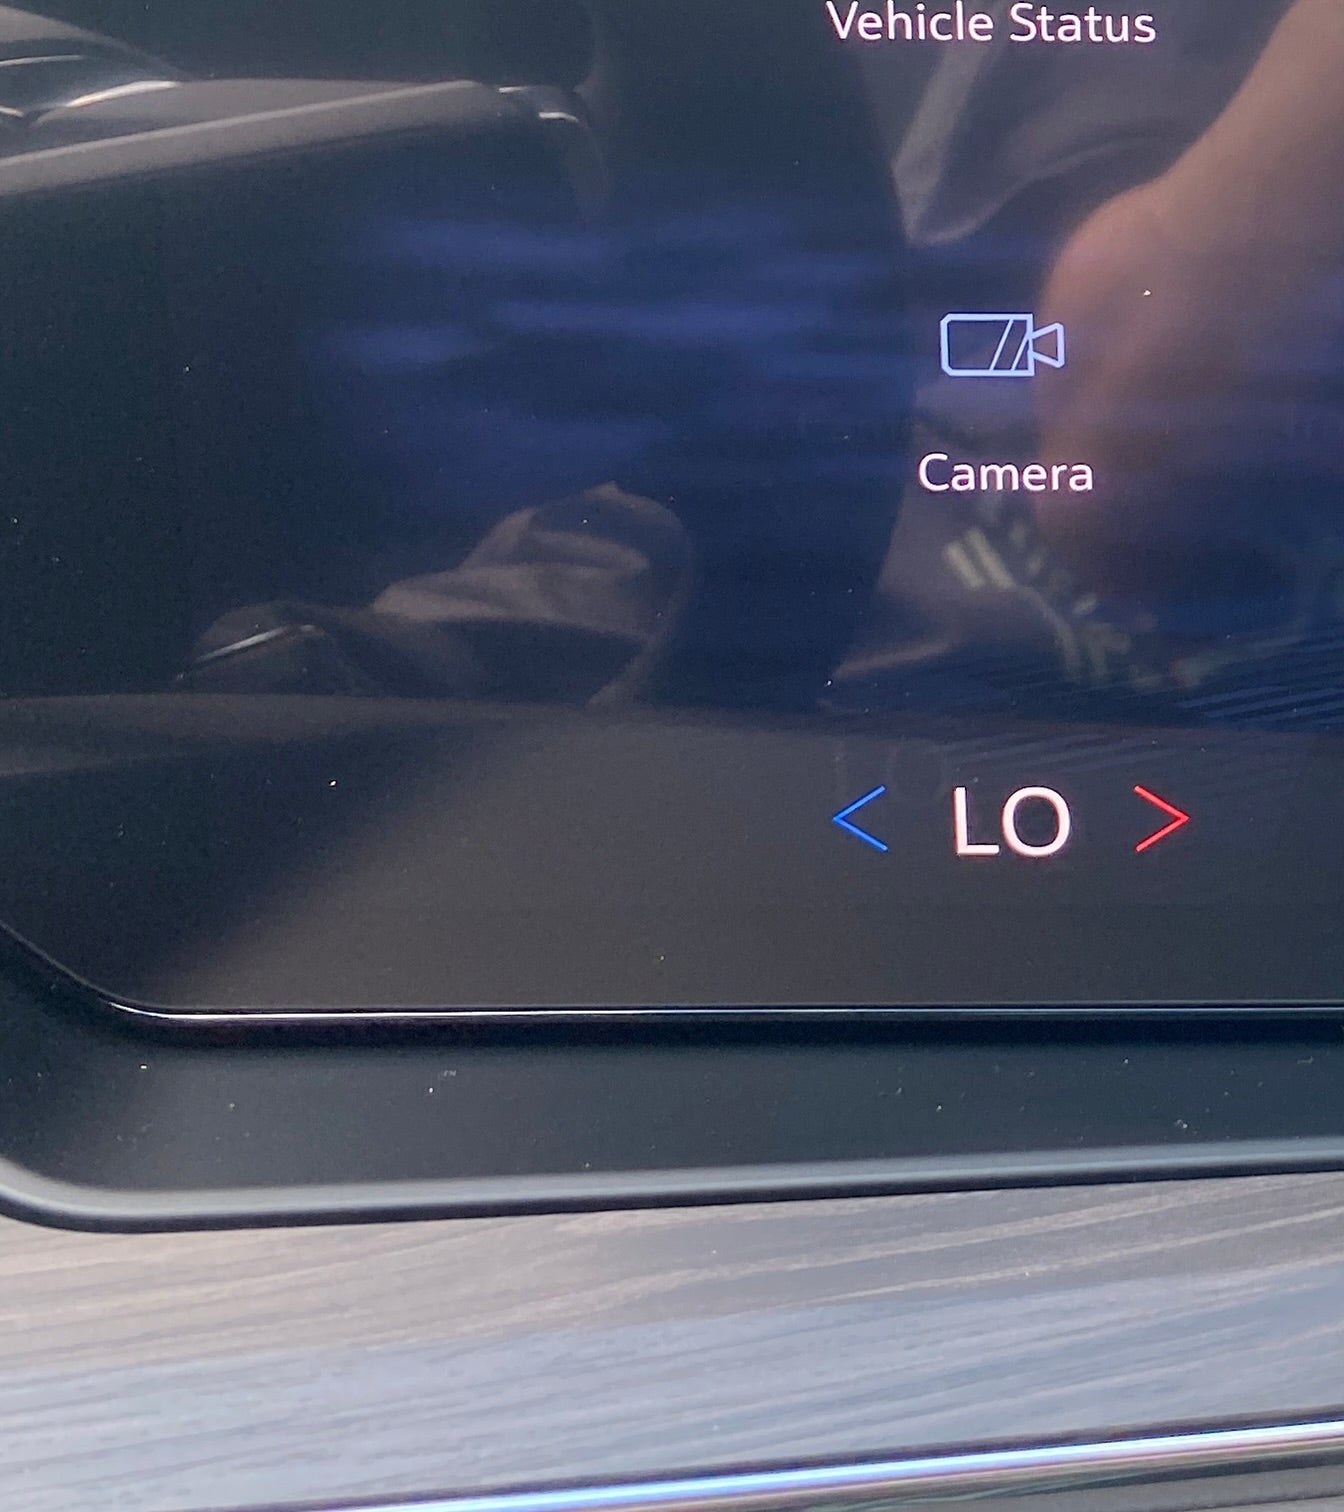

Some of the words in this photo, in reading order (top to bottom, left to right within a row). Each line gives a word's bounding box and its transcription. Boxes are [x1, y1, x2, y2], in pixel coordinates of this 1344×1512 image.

[825, 0, 994, 42] Vehicle
[1009, 2, 1156, 43] Status
[919, 453, 1093, 492] Camera
[954, 786, 1071, 857] LO
